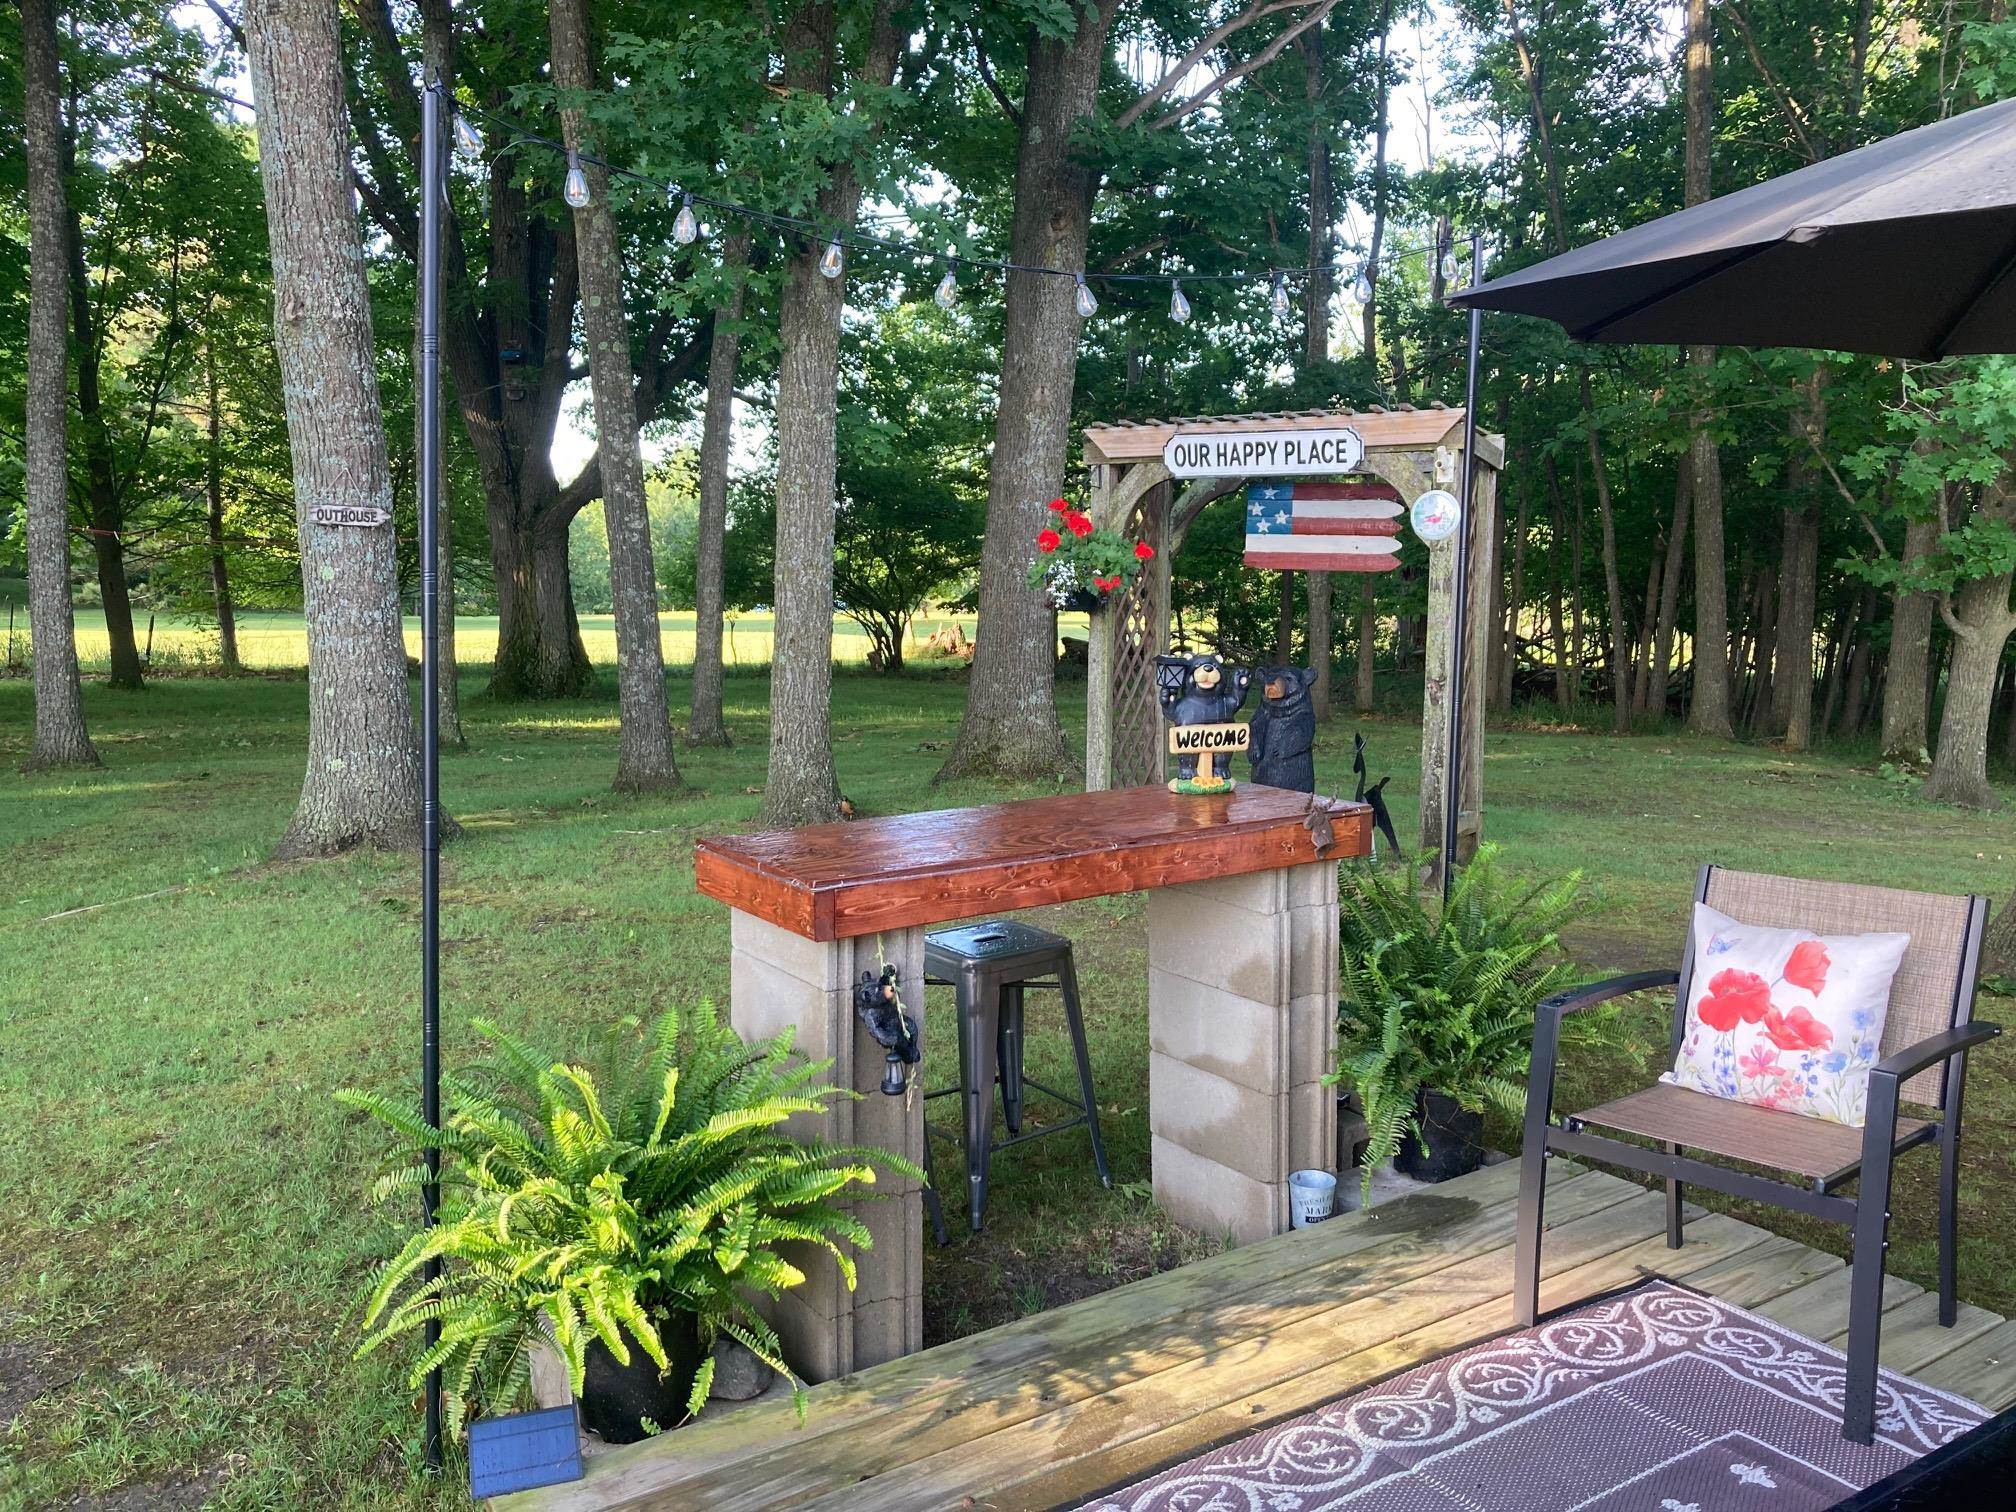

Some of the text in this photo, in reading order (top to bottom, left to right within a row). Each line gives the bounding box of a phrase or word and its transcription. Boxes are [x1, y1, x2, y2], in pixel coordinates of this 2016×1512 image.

[1174, 438, 1348, 468] OUR HAPPY PLACE
[316, 508, 378, 523] OUTHOUSE
